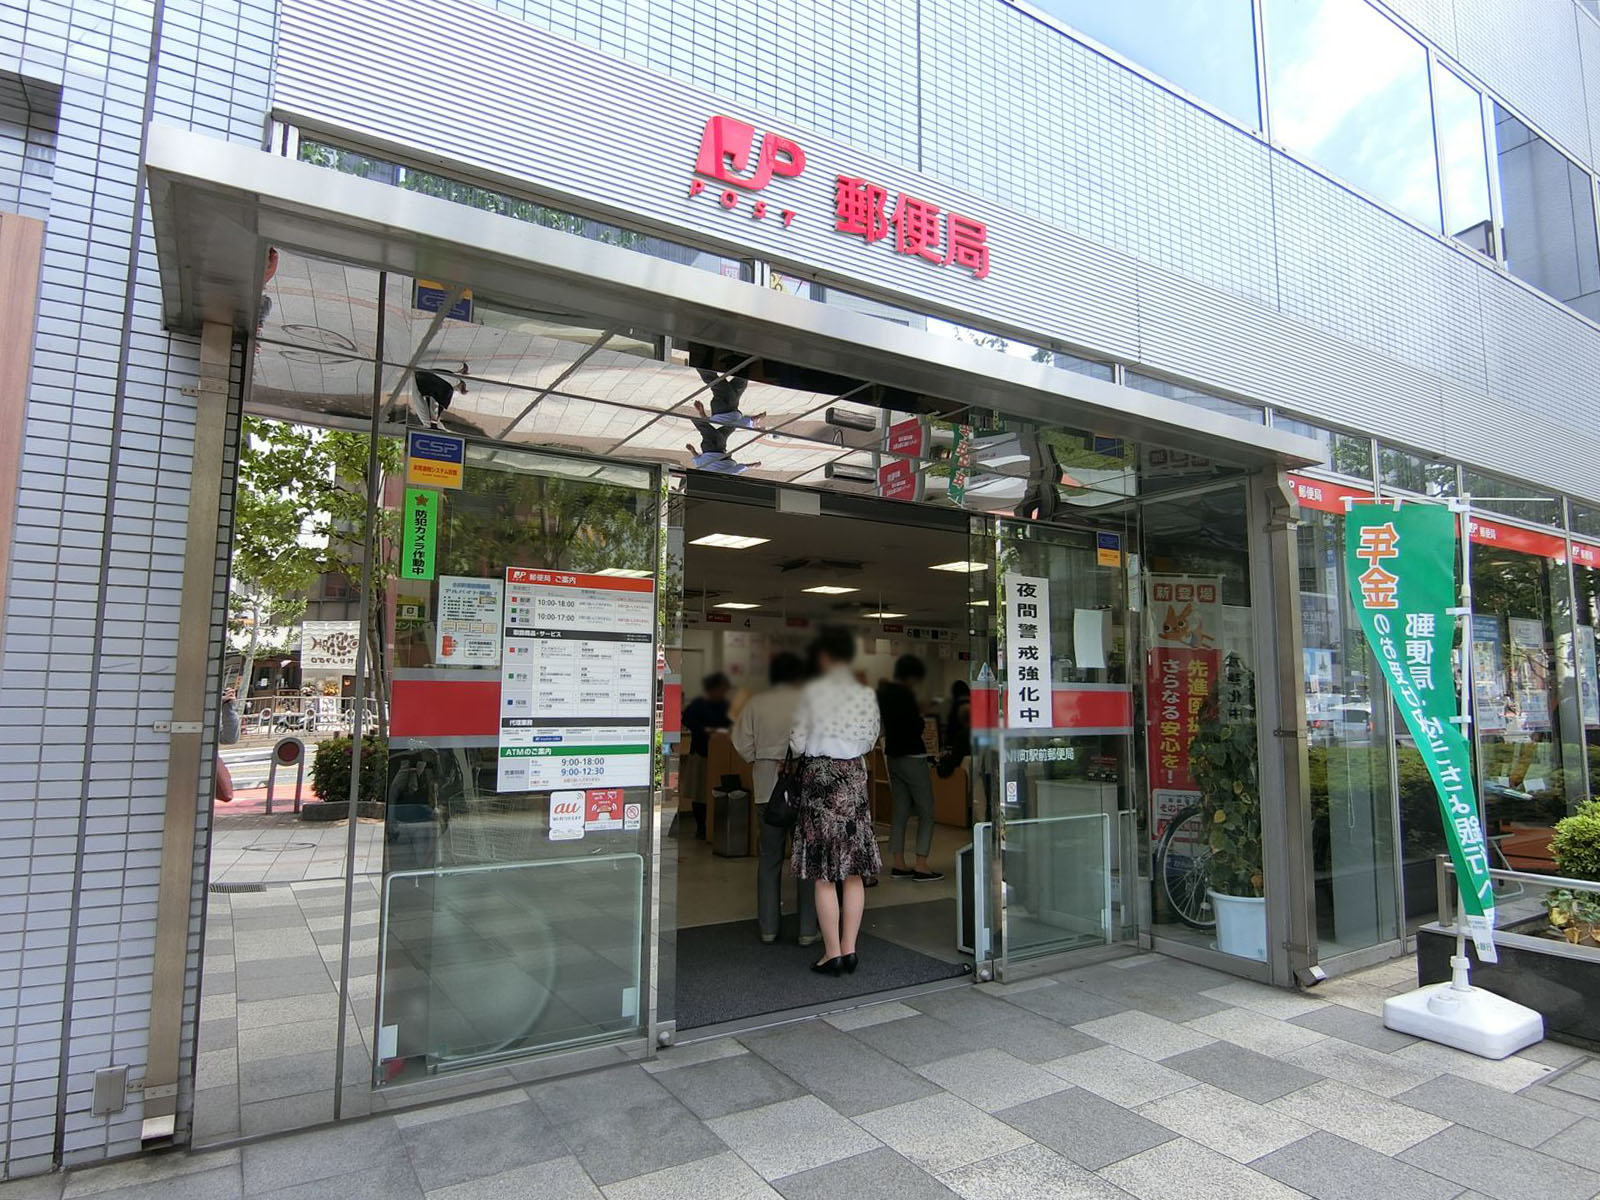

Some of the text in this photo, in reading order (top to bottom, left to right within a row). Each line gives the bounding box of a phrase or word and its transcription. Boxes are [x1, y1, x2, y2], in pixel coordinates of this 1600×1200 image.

[688, 177, 797, 228] POST
[834, 174, 990, 279] 郵便局
[415, 439, 458, 454] CSP
[1298, 485, 1323, 502] 郵便局
[1480, 526, 1496, 540] 郵便局
[411, 508, 428, 576] 防犯カメラ作動中
[529, 573, 551, 583] 郵便局
[555, 575, 577, 585] ご案内
[1157, 586, 1214, 600] 新登場
[537, 599, 576, 608] 10:00-18:00
[537, 612, 576, 622] 10:00-17:00
[1016, 582, 1041, 723] 夜間警戒強化中
[505, 747, 552, 756] ATMのご案内
[561, 757, 605, 766] 9:00-18:00
[561, 767, 605, 777] 9:00-12:30
[553, 802, 581, 814] au
